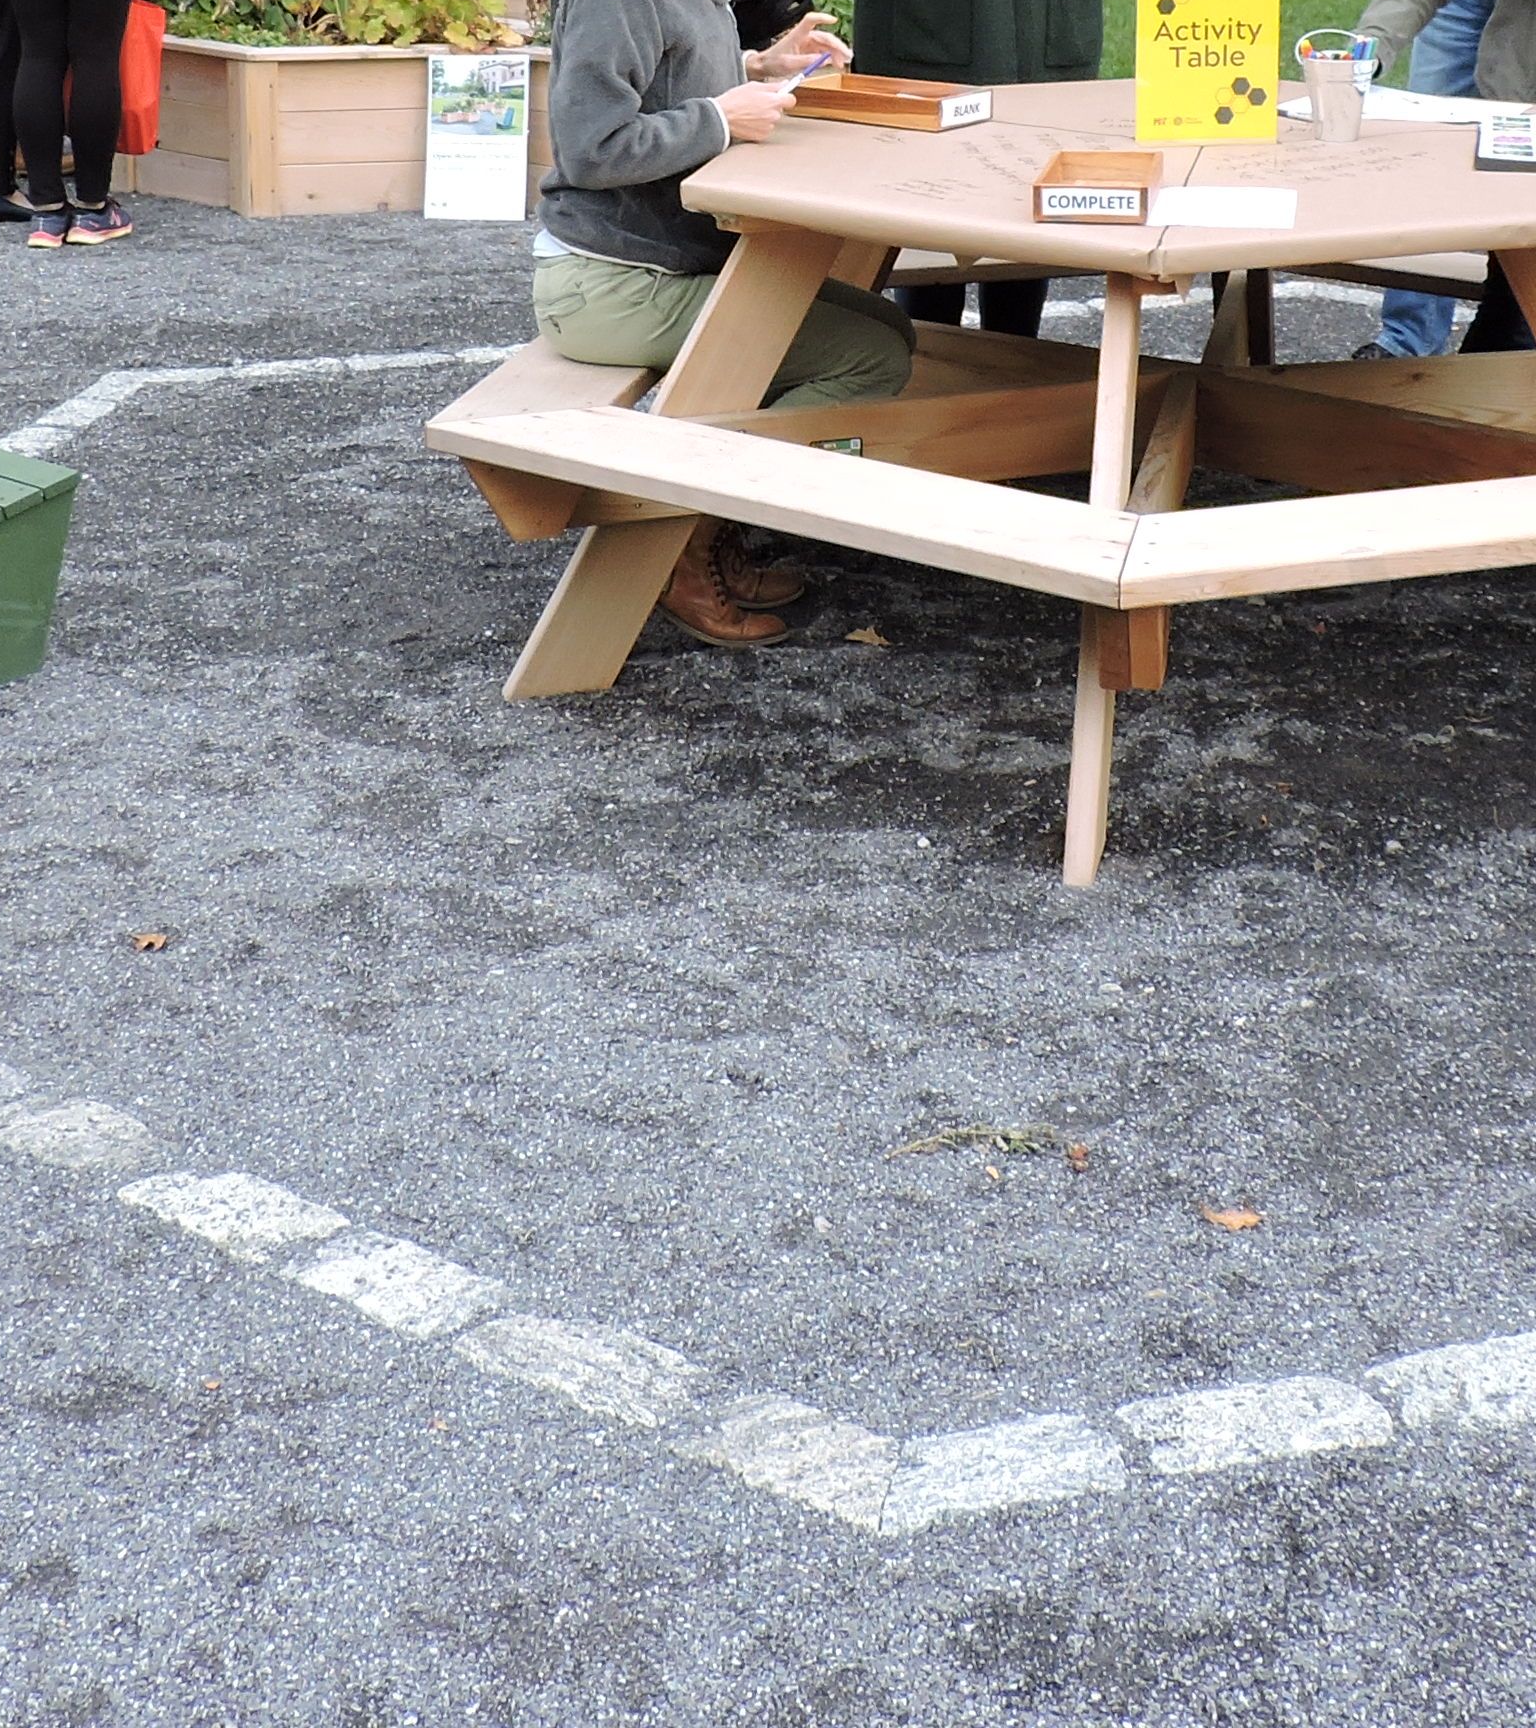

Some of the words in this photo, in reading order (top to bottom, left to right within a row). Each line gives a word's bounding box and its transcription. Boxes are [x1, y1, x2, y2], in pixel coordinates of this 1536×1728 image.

[1153, 17, 1263, 46] Activity
[1168, 44, 1246, 69] Table
[953, 103, 981, 118] BLANK
[1047, 195, 1136, 210] COMPLETE
